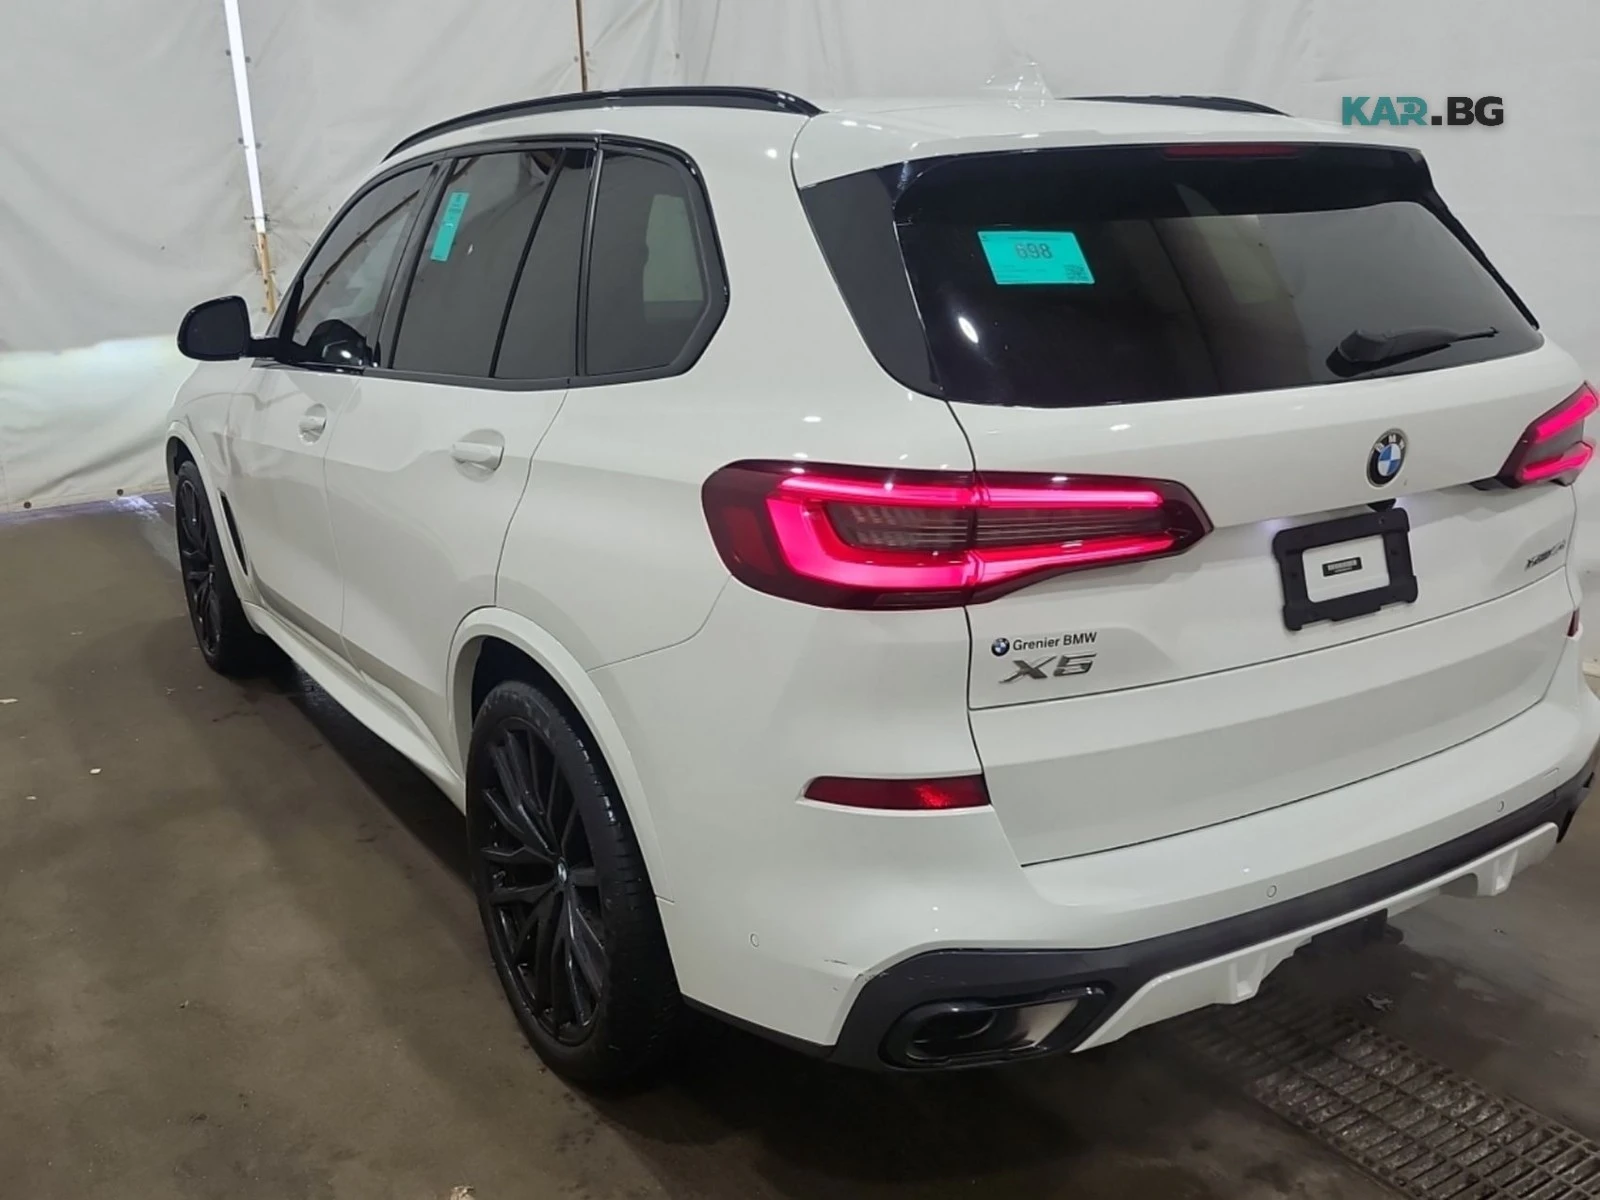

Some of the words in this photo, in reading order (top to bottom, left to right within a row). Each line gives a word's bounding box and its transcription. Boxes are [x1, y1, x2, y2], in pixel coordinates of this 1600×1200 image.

[1015, 243, 1053, 259] 698
[1013, 637, 1061, 651] Grenier
[1063, 632, 1097, 646] BMW
[998, 653, 1097, 684] X5
